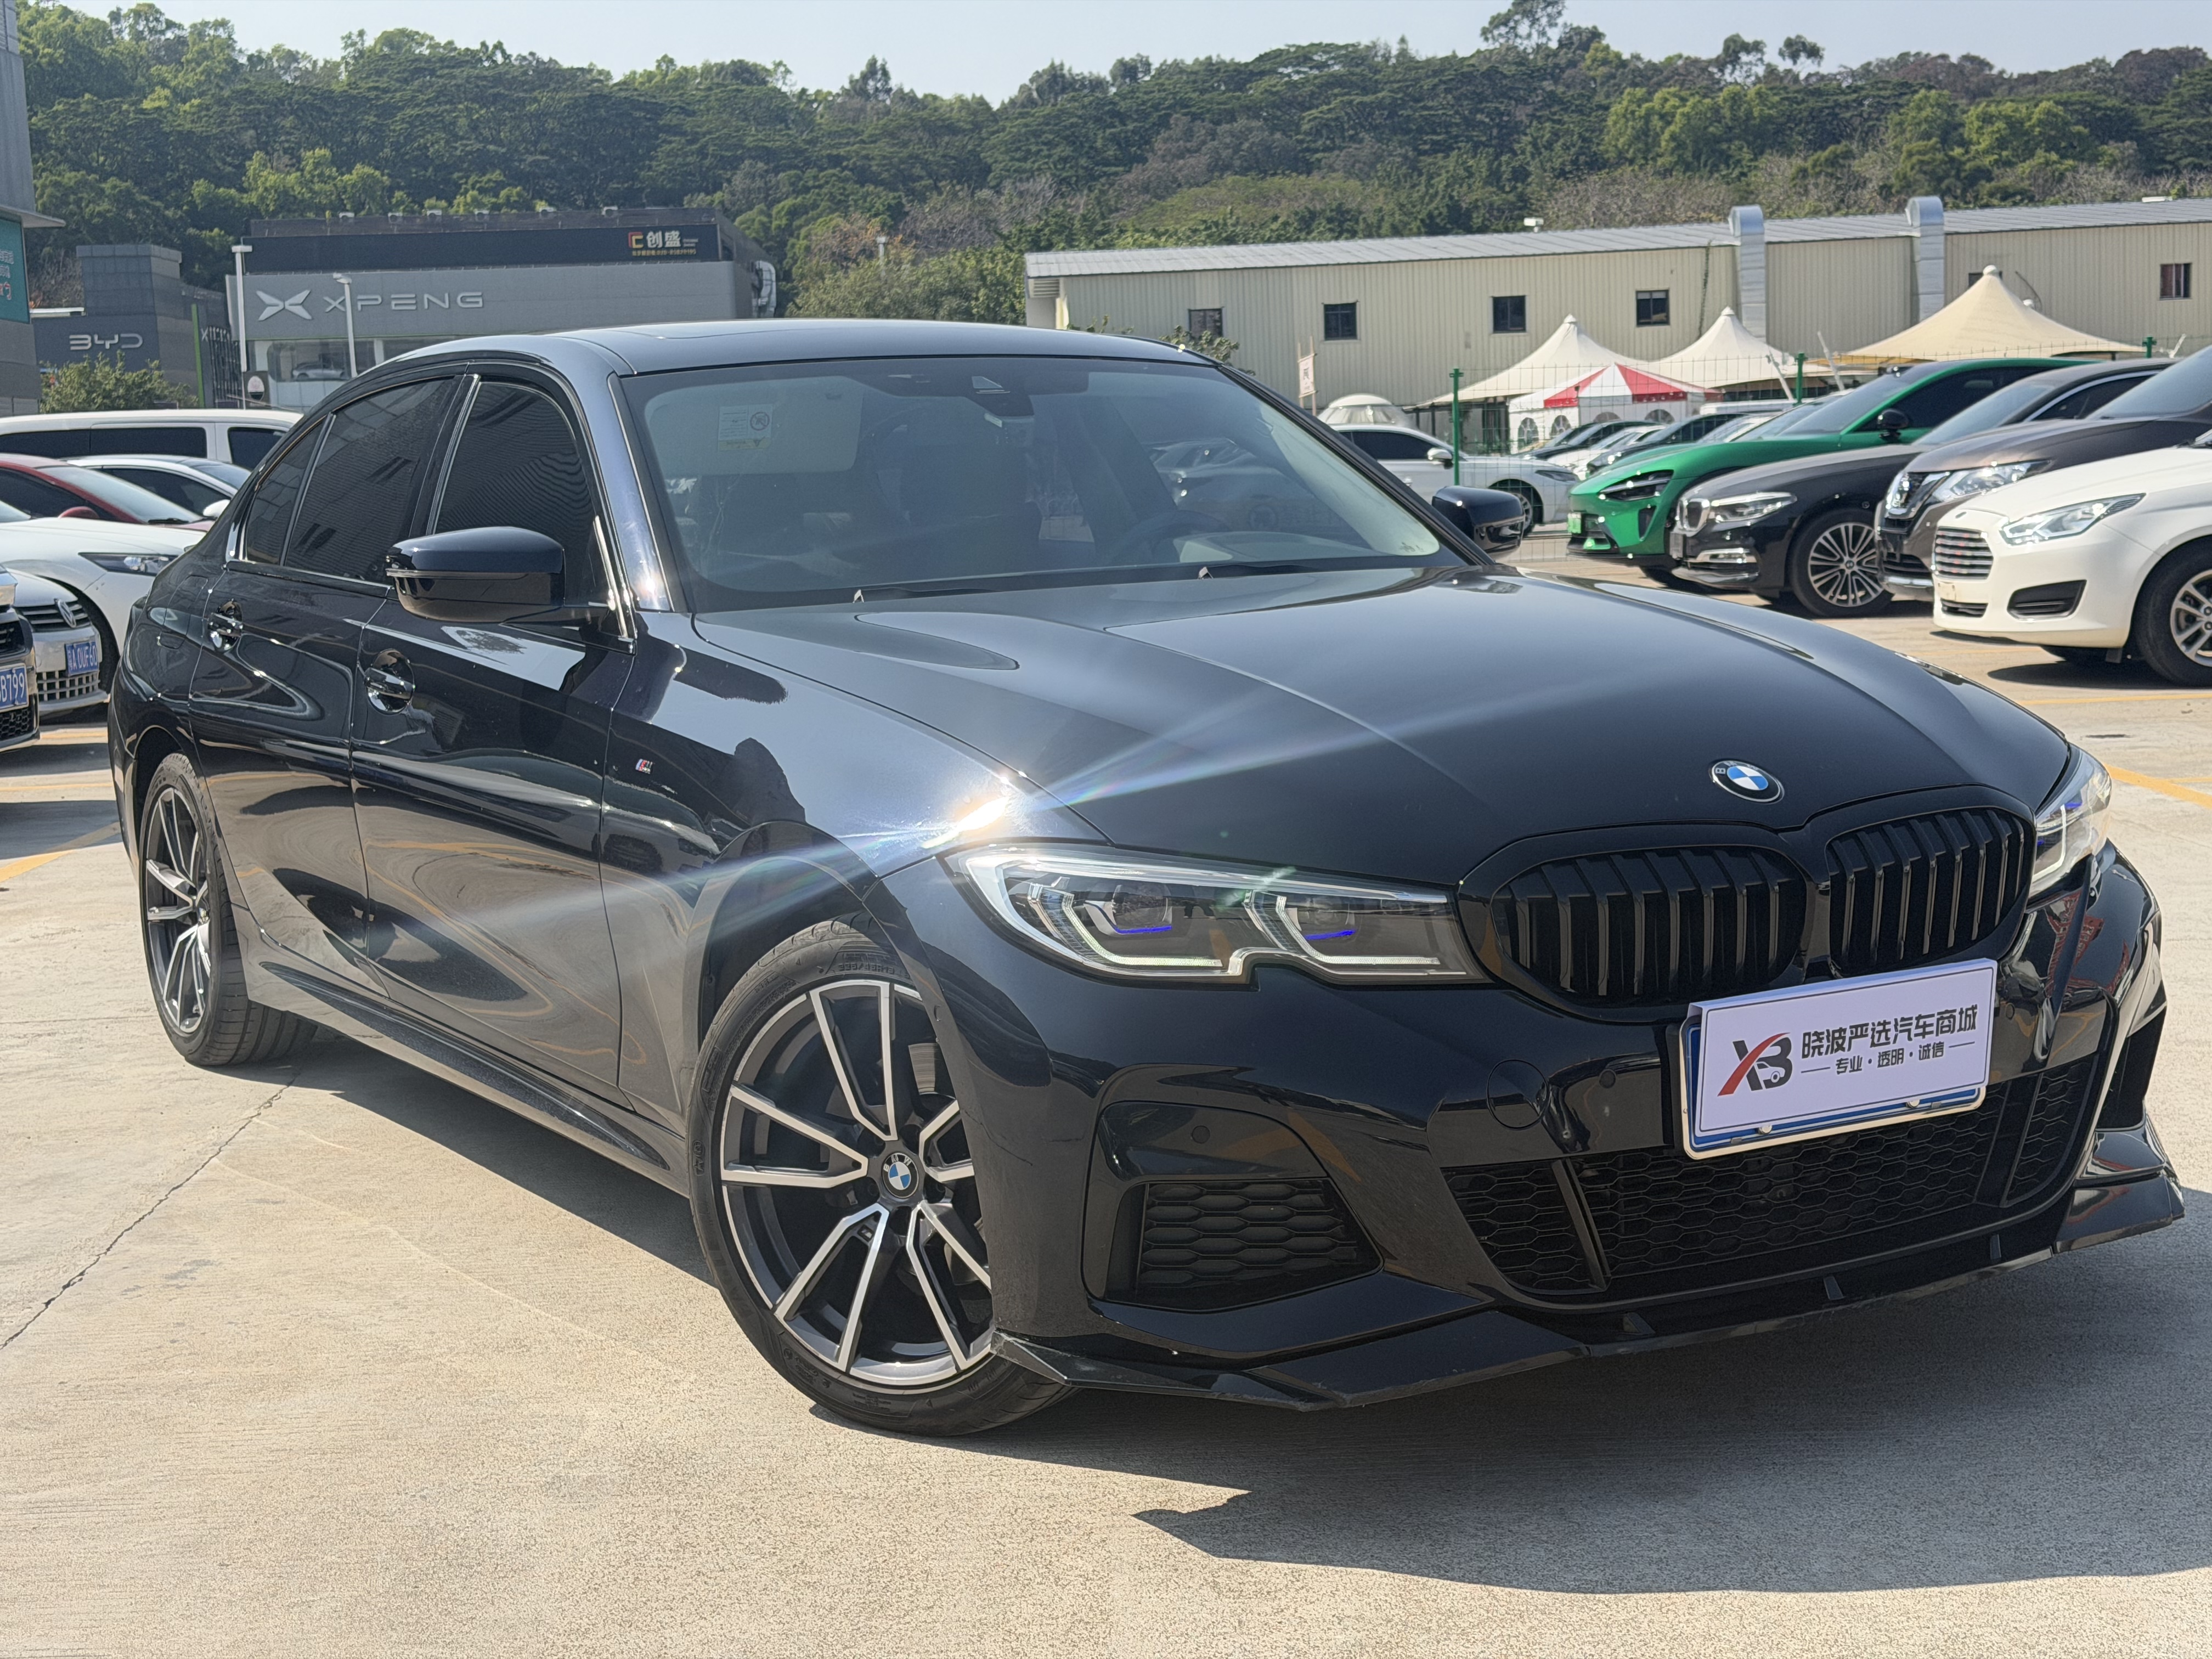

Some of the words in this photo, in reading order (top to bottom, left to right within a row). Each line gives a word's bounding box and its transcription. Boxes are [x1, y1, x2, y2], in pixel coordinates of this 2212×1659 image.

[647, 230, 681, 248] 创盛
[323, 291, 484, 313] XPENG
[69, 333, 143, 351] BYD
[0, 672, 25, 703] B799
[1801, 1005, 1978, 1059] 晓波严选汽车商城
[883, 1154, 913, 1172] BMW
